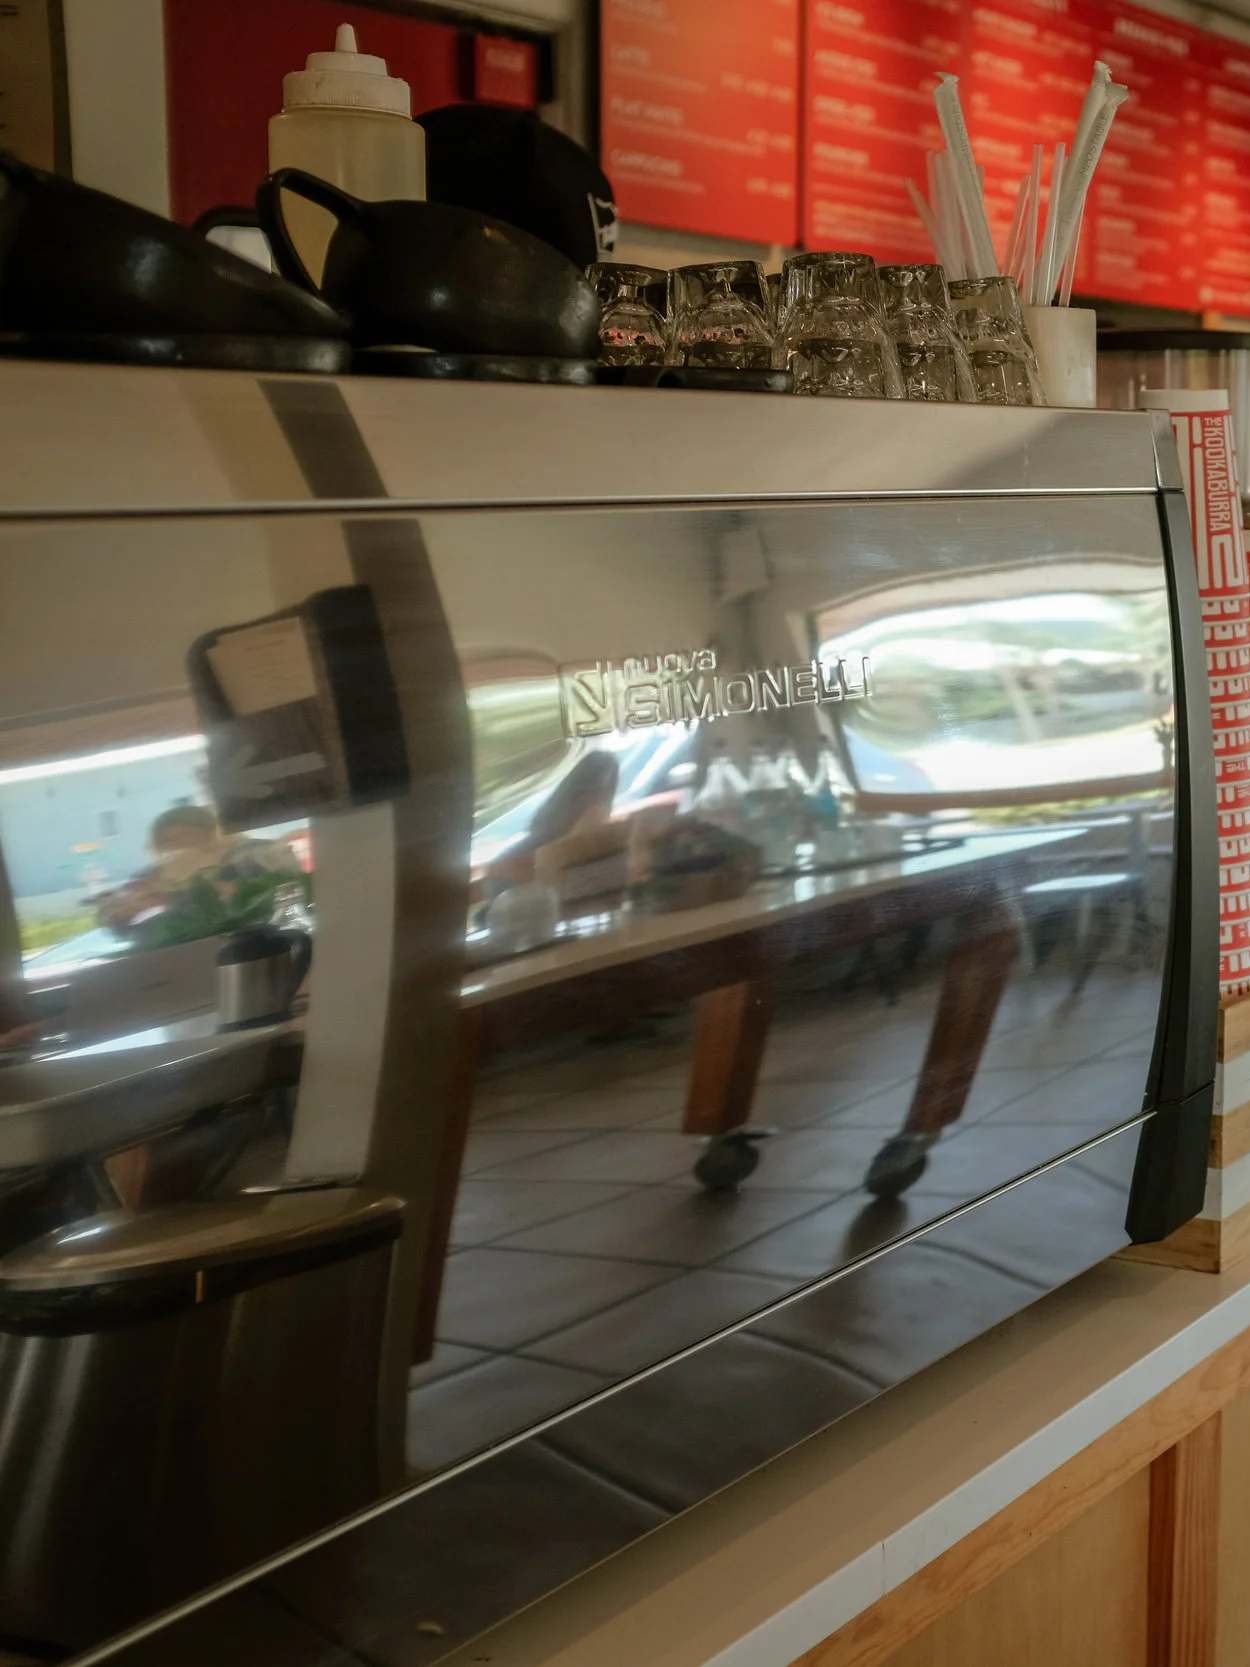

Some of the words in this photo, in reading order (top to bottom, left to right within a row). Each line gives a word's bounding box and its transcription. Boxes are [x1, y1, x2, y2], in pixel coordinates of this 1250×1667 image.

[1076, 112, 1109, 191] MPOSTABLE
[1204, 427, 1232, 532] KOOKABURRA
[626, 656, 873, 729] SIMONELLI
